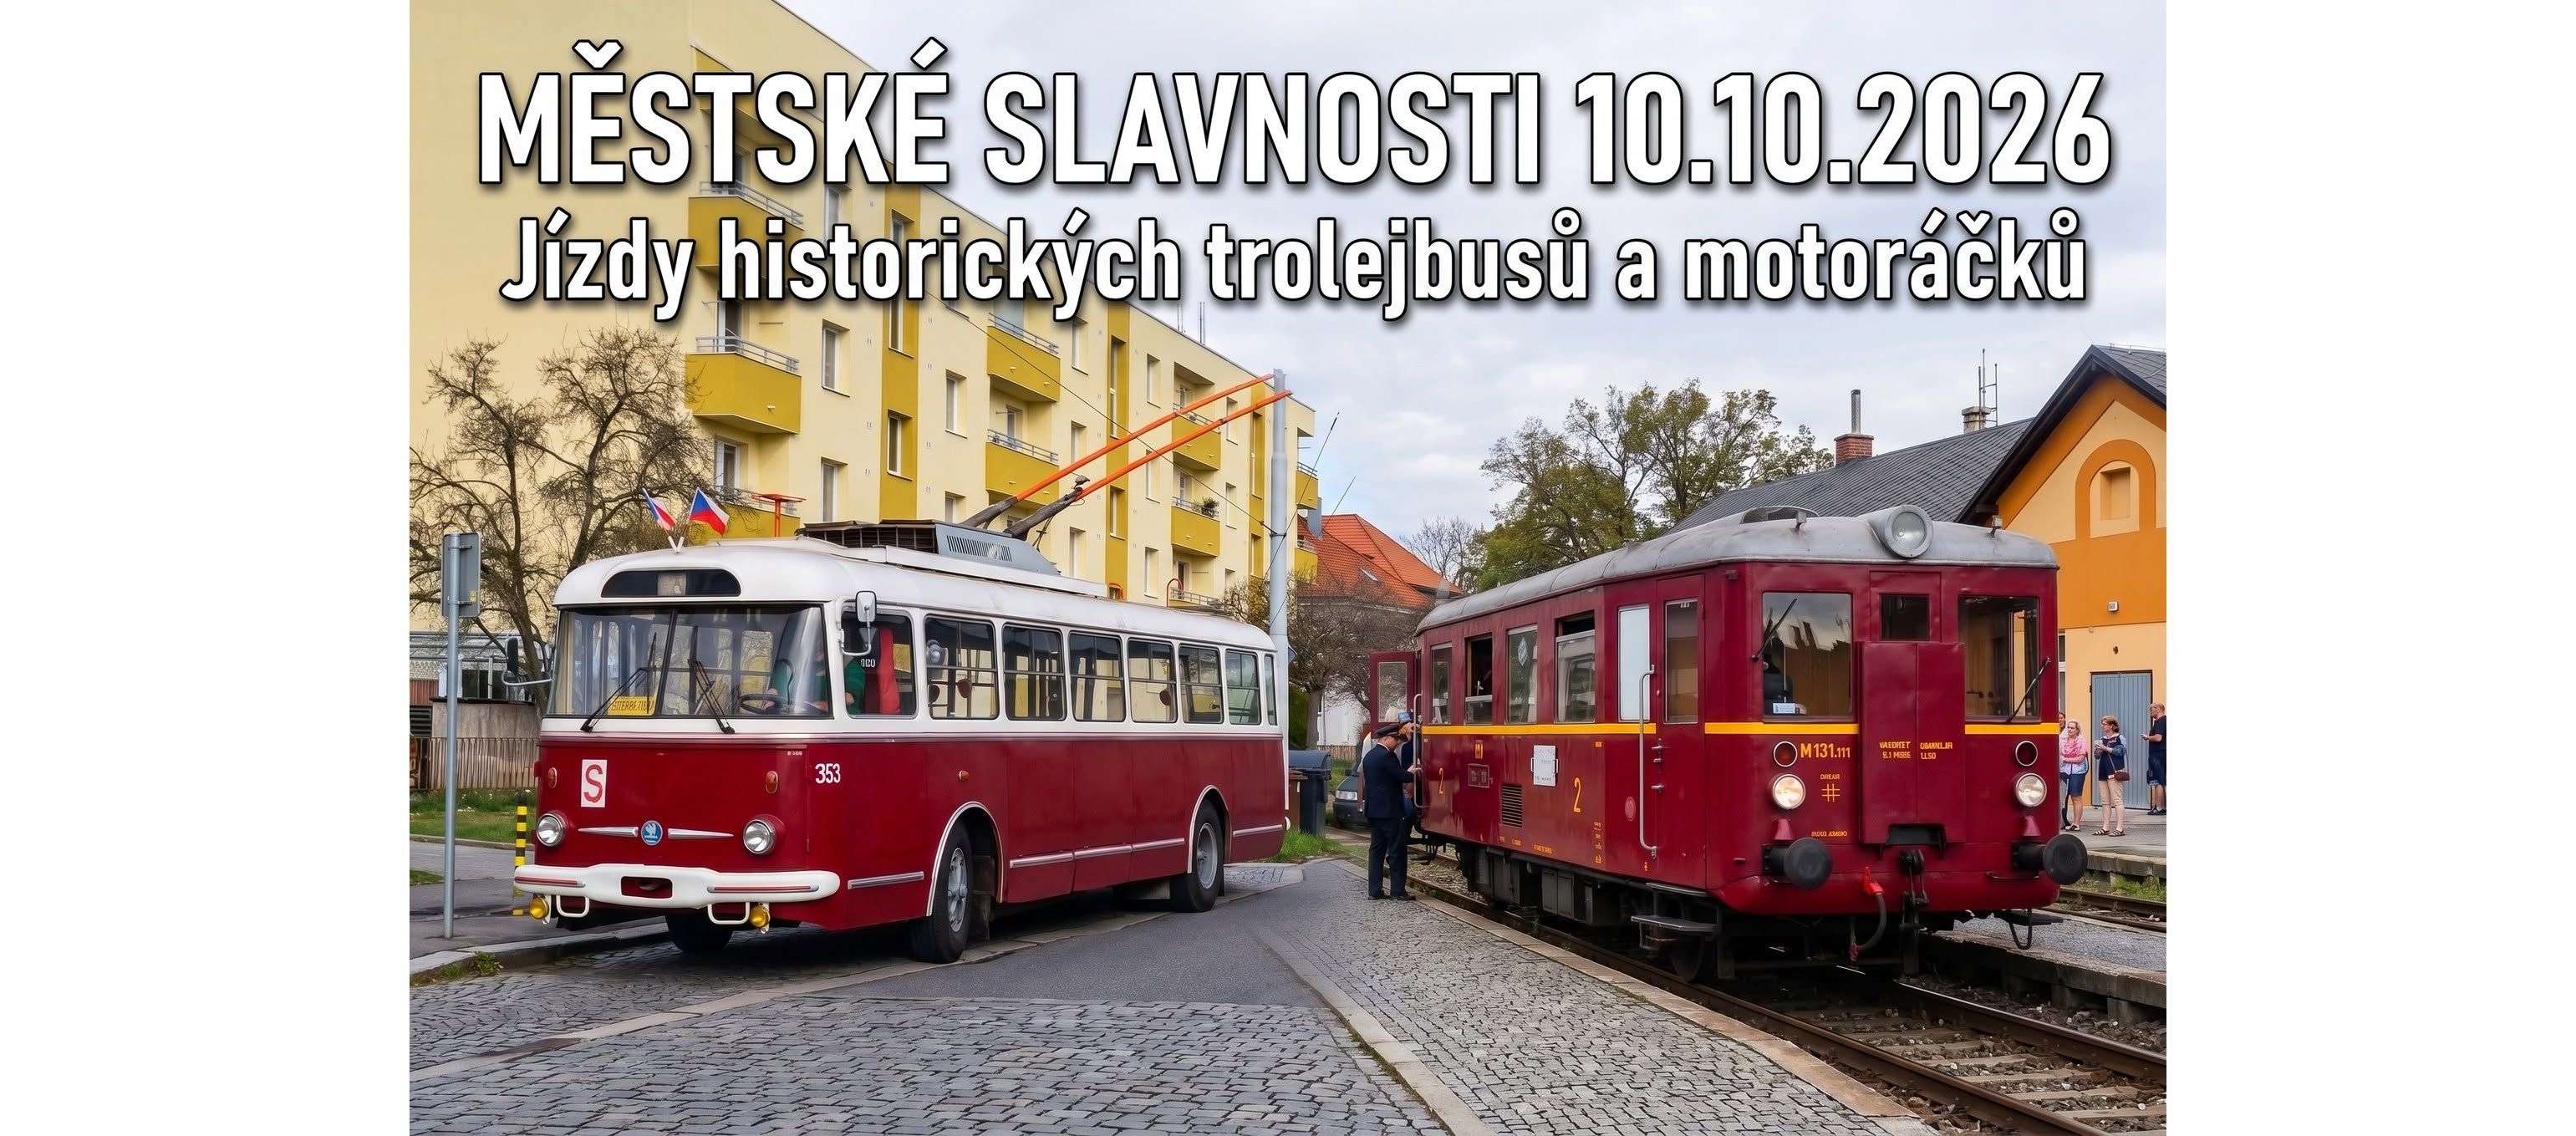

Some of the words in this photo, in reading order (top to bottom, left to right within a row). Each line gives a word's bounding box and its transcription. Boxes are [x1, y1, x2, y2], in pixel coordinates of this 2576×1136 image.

[583, 764, 603, 803] S
[815, 763, 841, 783] 353
[1573, 777, 1581, 813] 2
